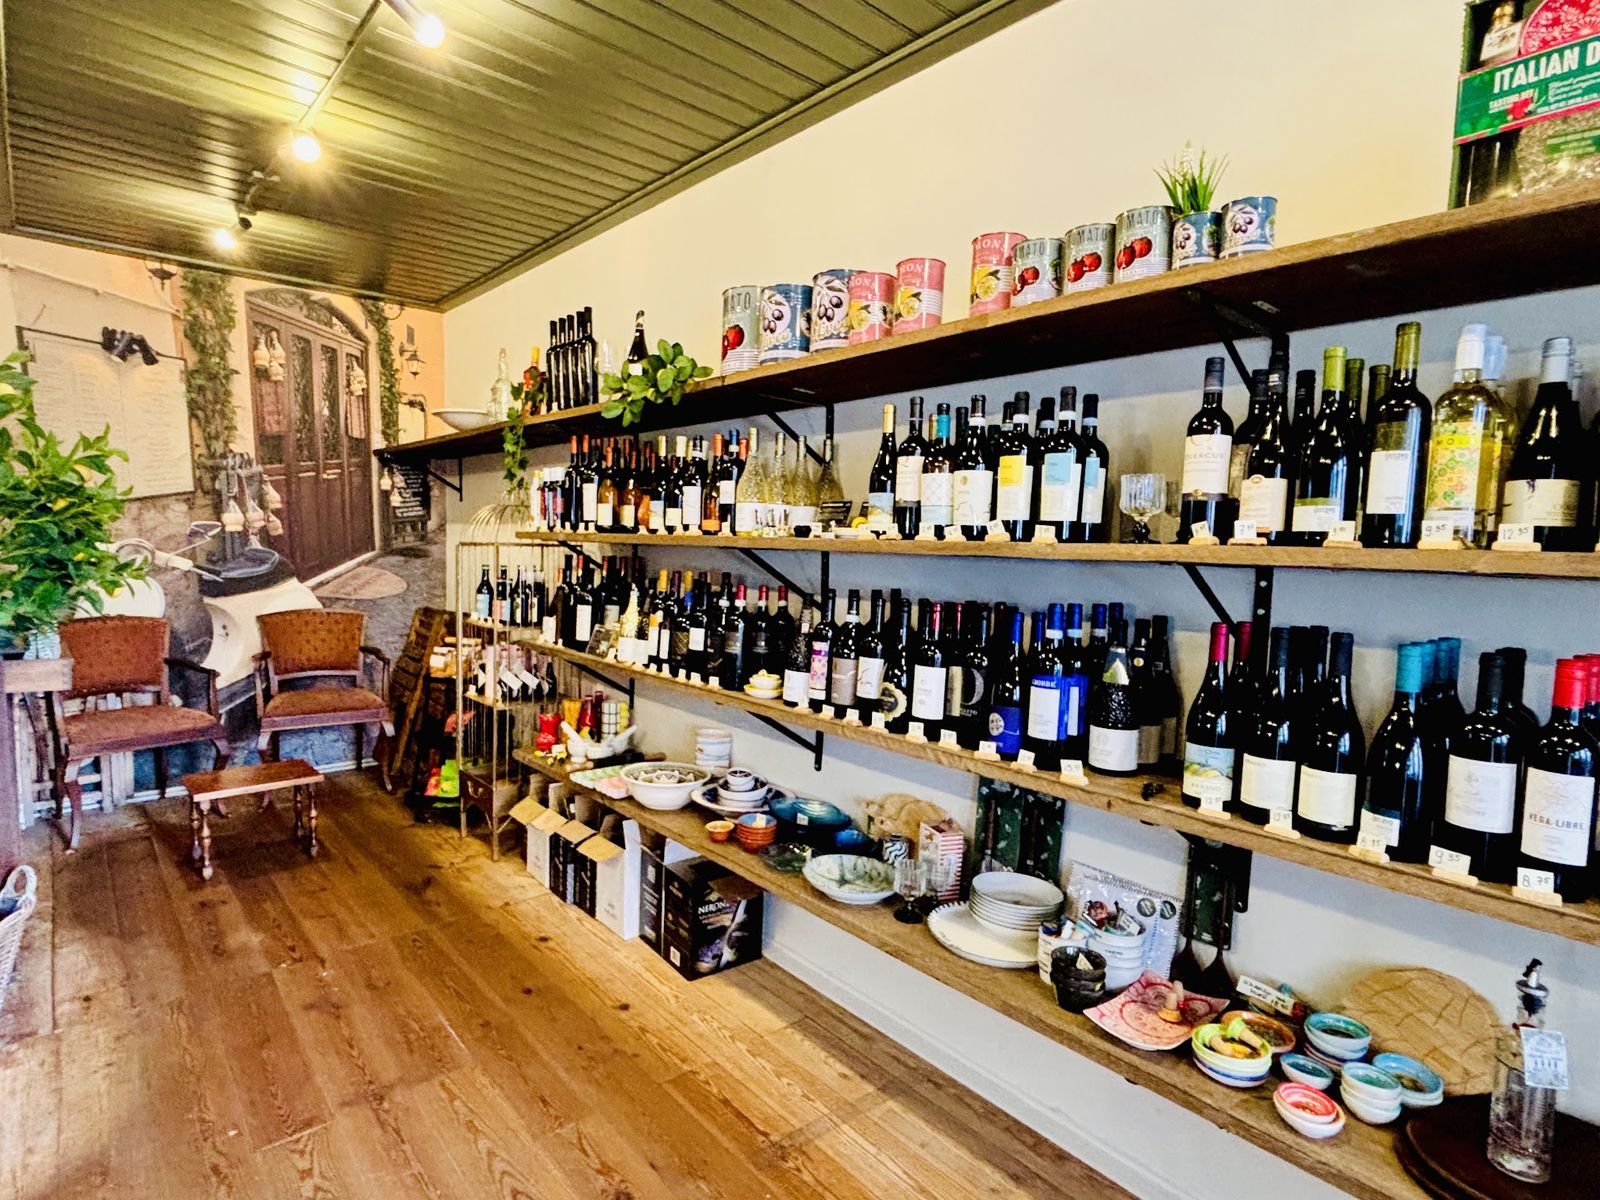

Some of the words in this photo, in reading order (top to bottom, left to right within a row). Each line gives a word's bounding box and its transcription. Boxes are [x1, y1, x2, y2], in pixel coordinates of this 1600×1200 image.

[1493, 45, 1580, 94] ITALIAN
[1529, 813, 1551, 825] VEGA
[1555, 819, 1585, 831] LIBRE
